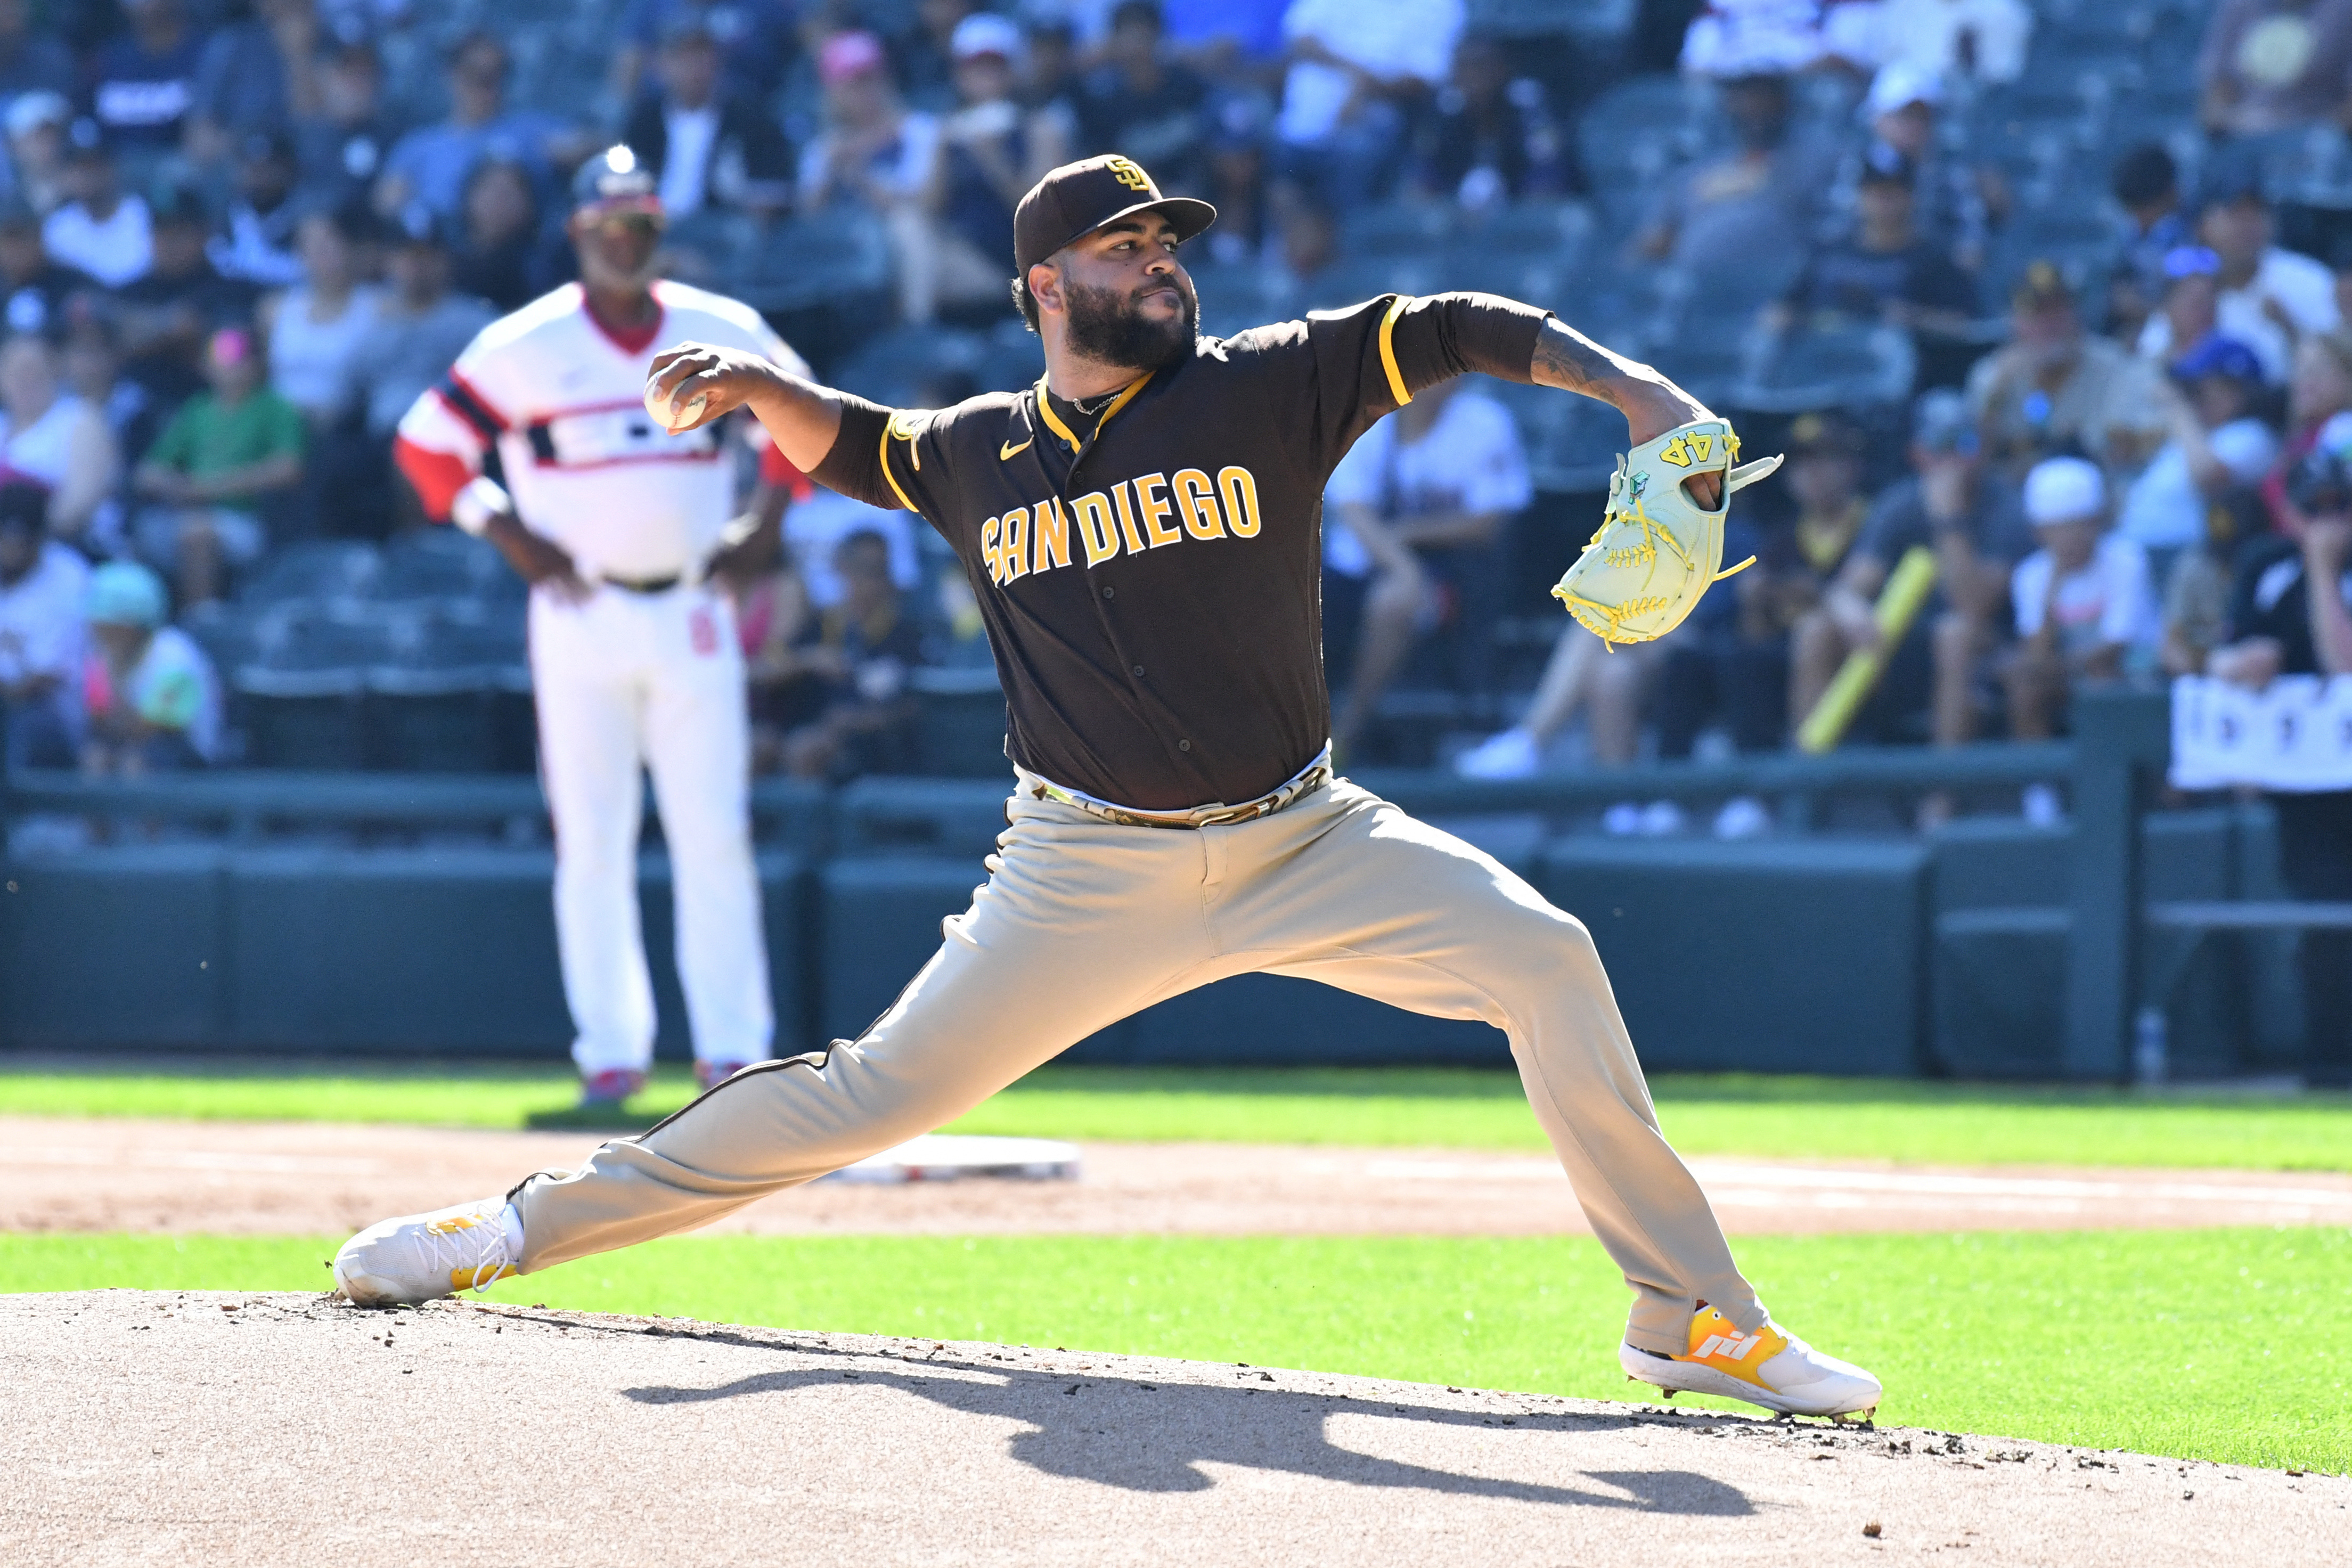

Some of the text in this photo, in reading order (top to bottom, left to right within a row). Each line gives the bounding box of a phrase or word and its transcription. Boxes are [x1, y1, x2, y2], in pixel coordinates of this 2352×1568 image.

[1105, 159, 1149, 191] SD
[1660, 431, 1713, 467] 44
[981, 466, 1261, 588] SAN DIEGO
